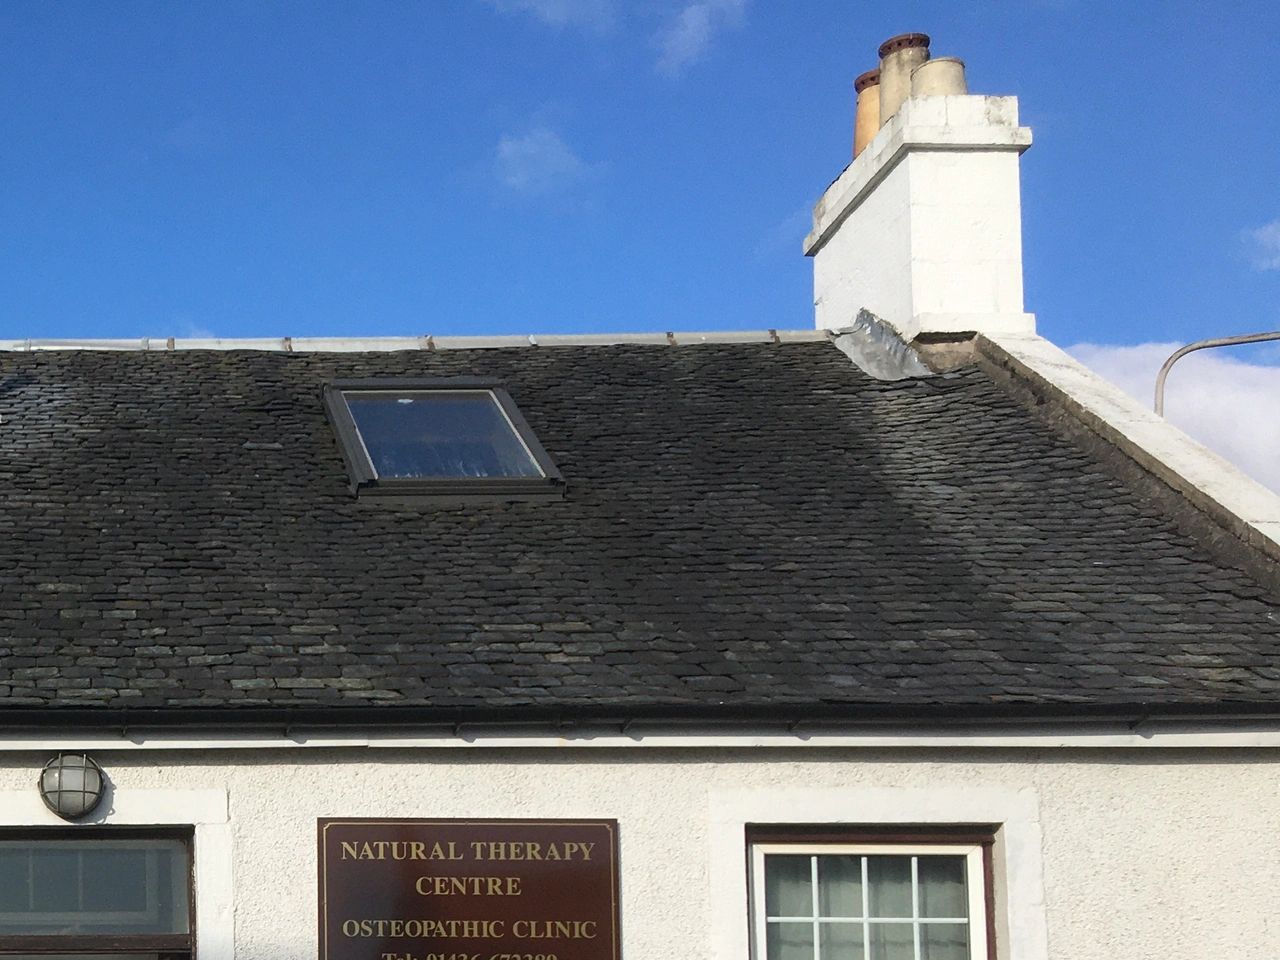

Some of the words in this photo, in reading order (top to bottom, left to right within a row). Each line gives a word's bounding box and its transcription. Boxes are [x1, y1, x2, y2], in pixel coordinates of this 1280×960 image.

[340, 841, 464, 860] NATURAL
[470, 841, 596, 861] THERAPY
[415, 876, 522, 896] CENTRE
[342, 919, 505, 938] OSTEOPATHIC
[512, 920, 597, 939] CLINIC
